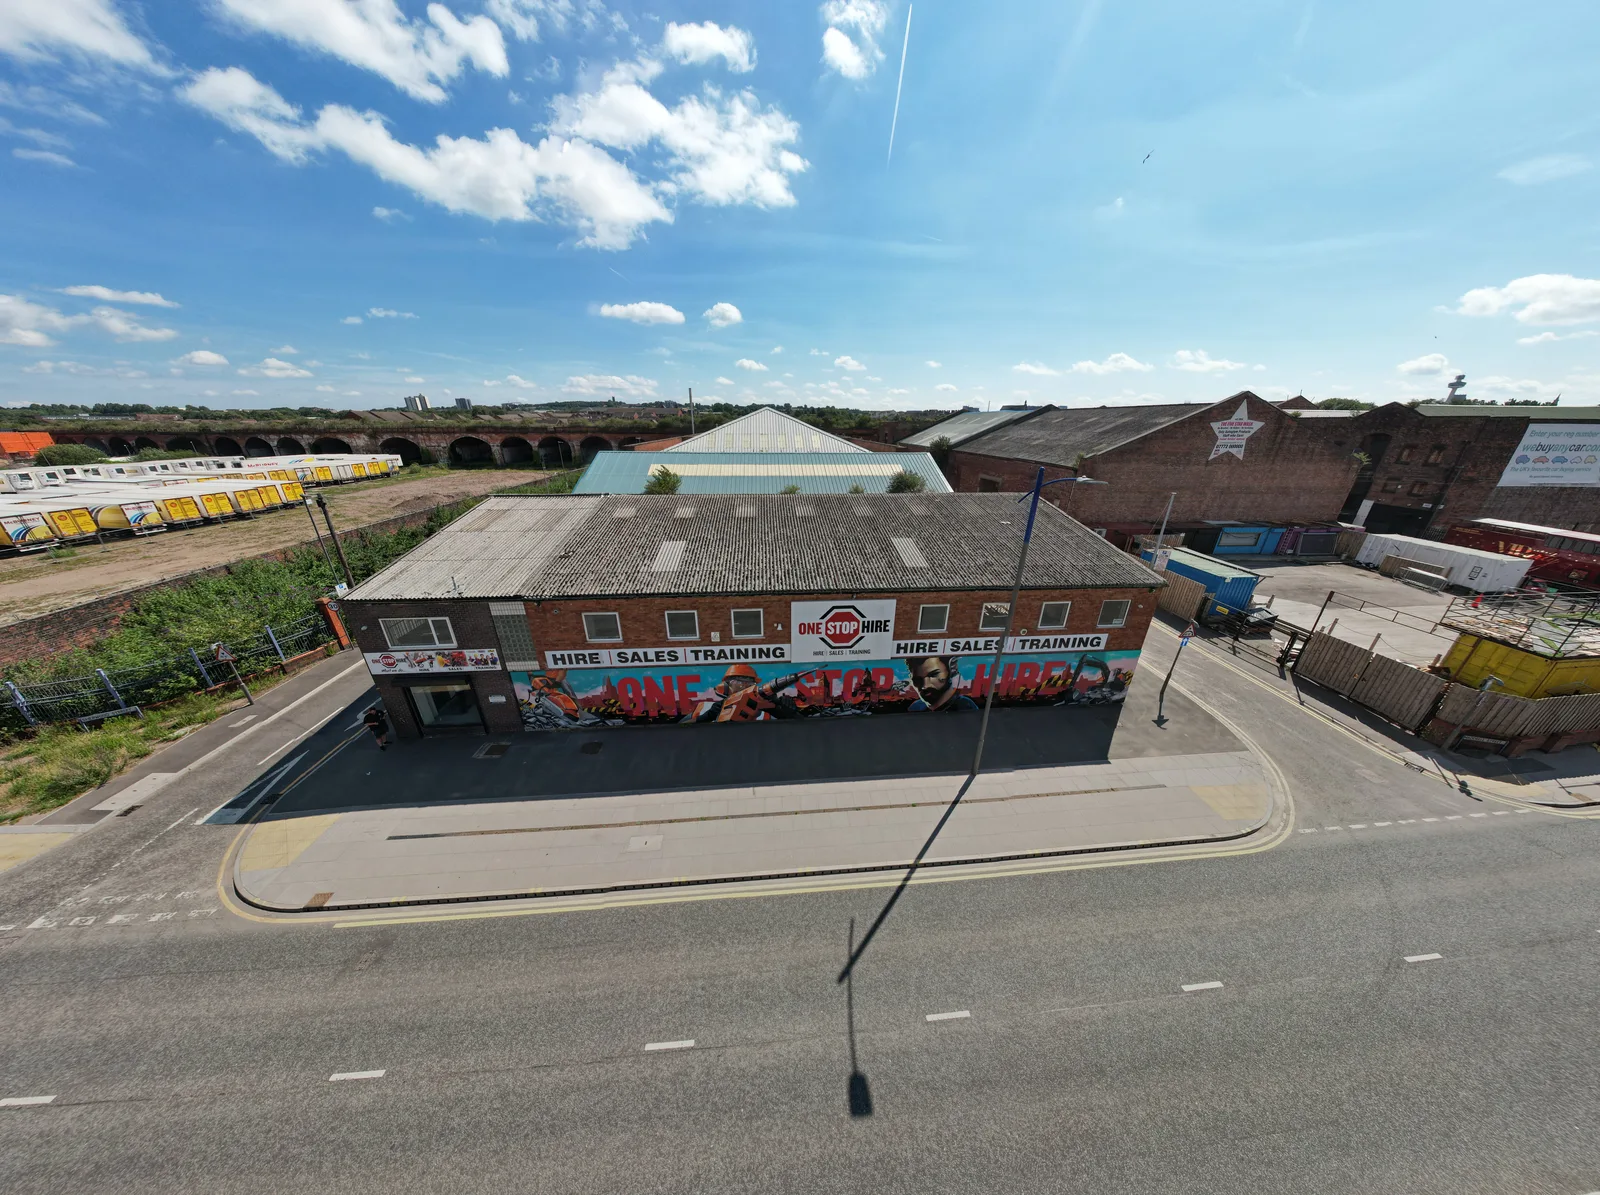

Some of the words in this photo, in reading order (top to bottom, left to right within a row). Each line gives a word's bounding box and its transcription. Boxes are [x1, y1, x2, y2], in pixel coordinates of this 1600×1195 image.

[798, 622, 822, 635] ONE
[827, 621, 858, 635] STOP
[861, 620, 890, 633] HIRE
[552, 653, 601, 665] HIRE
[616, 650, 679, 664] SALES
[690, 647, 785, 661] TRAINING
[896, 642, 939, 654] HIRE
[1019, 636, 1102, 650] TRAINING
[794, 668, 894, 708] STOP
[971, 661, 1067, 697] HIRE
[617, 674, 701, 717] ONE
